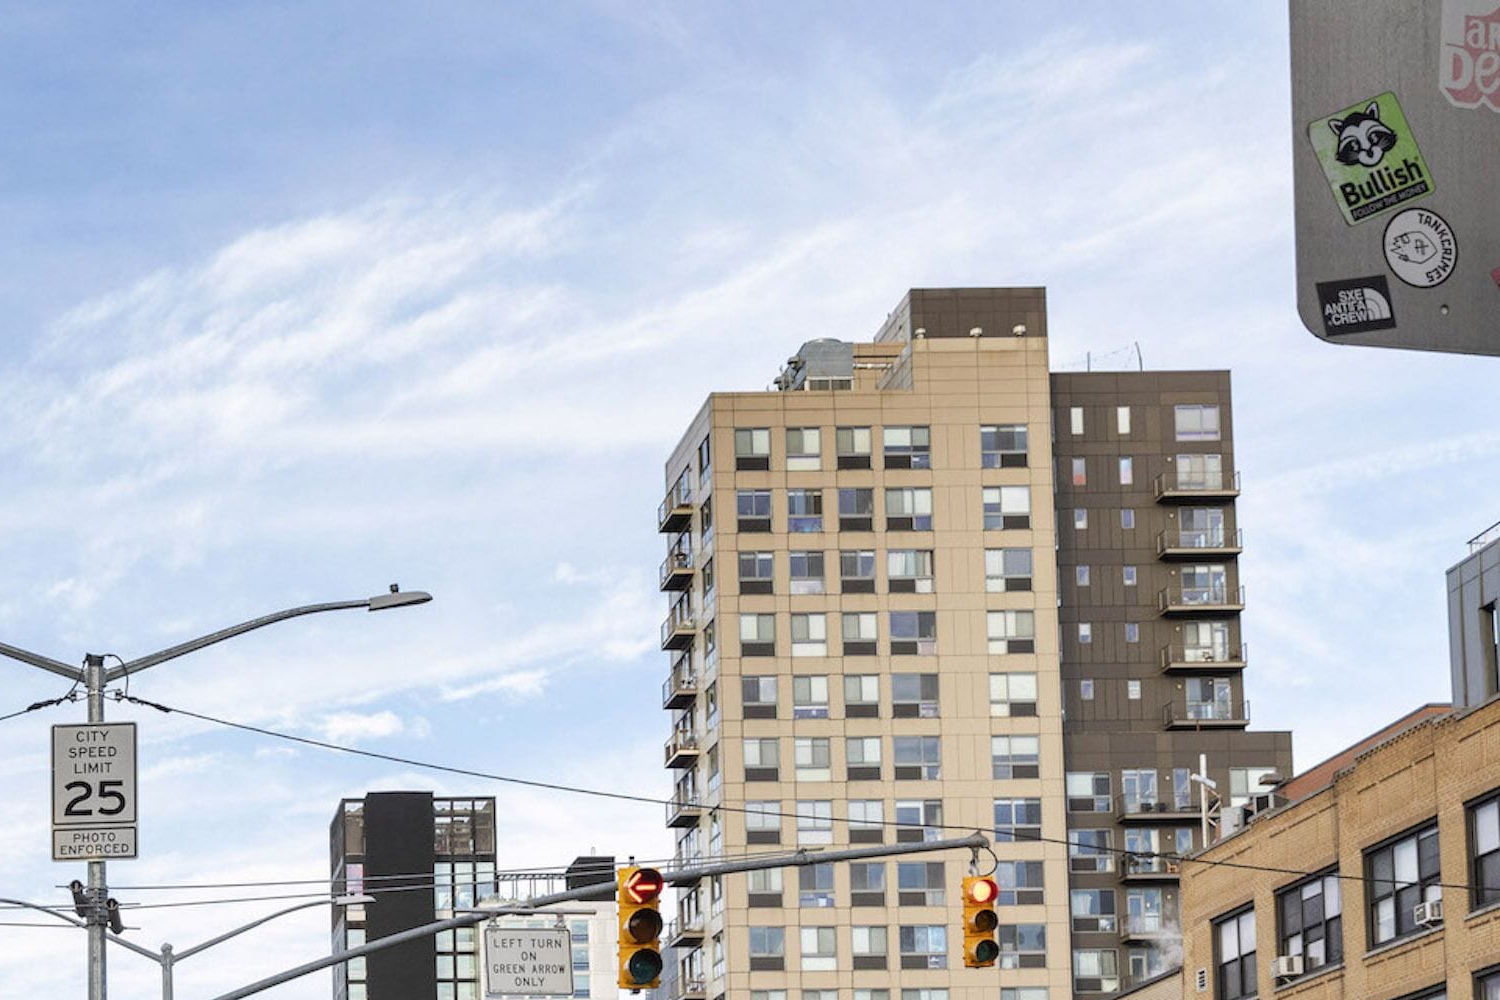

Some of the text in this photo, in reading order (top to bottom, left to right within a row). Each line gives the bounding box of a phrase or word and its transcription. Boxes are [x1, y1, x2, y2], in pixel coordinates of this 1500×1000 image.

[1340, 159, 1424, 207] Bullish
[1353, 201, 1383, 217] FOLLOW
[1398, 184, 1427, 200] MONEY
[1418, 212, 1452, 283] TANKCRIMES
[1338, 288, 1364, 301] SXE
[1325, 300, 1366, 316] ANTIFA
[1330, 311, 1369, 326] CREW
[76, 730, 110, 742] CITY
[68, 747, 117, 758] SPEED
[74, 762, 113, 774] LIMIT
[64, 781, 126, 815] 25
[73, 832, 116, 843] PHOTO
[60, 843, 129, 855] ENFORCED
[493, 939, 562, 948] LEFT TURN
[521, 952, 537, 961] ON
[493, 964, 565, 974] GREEN ARROW
[514, 977, 545, 987] ONLY
